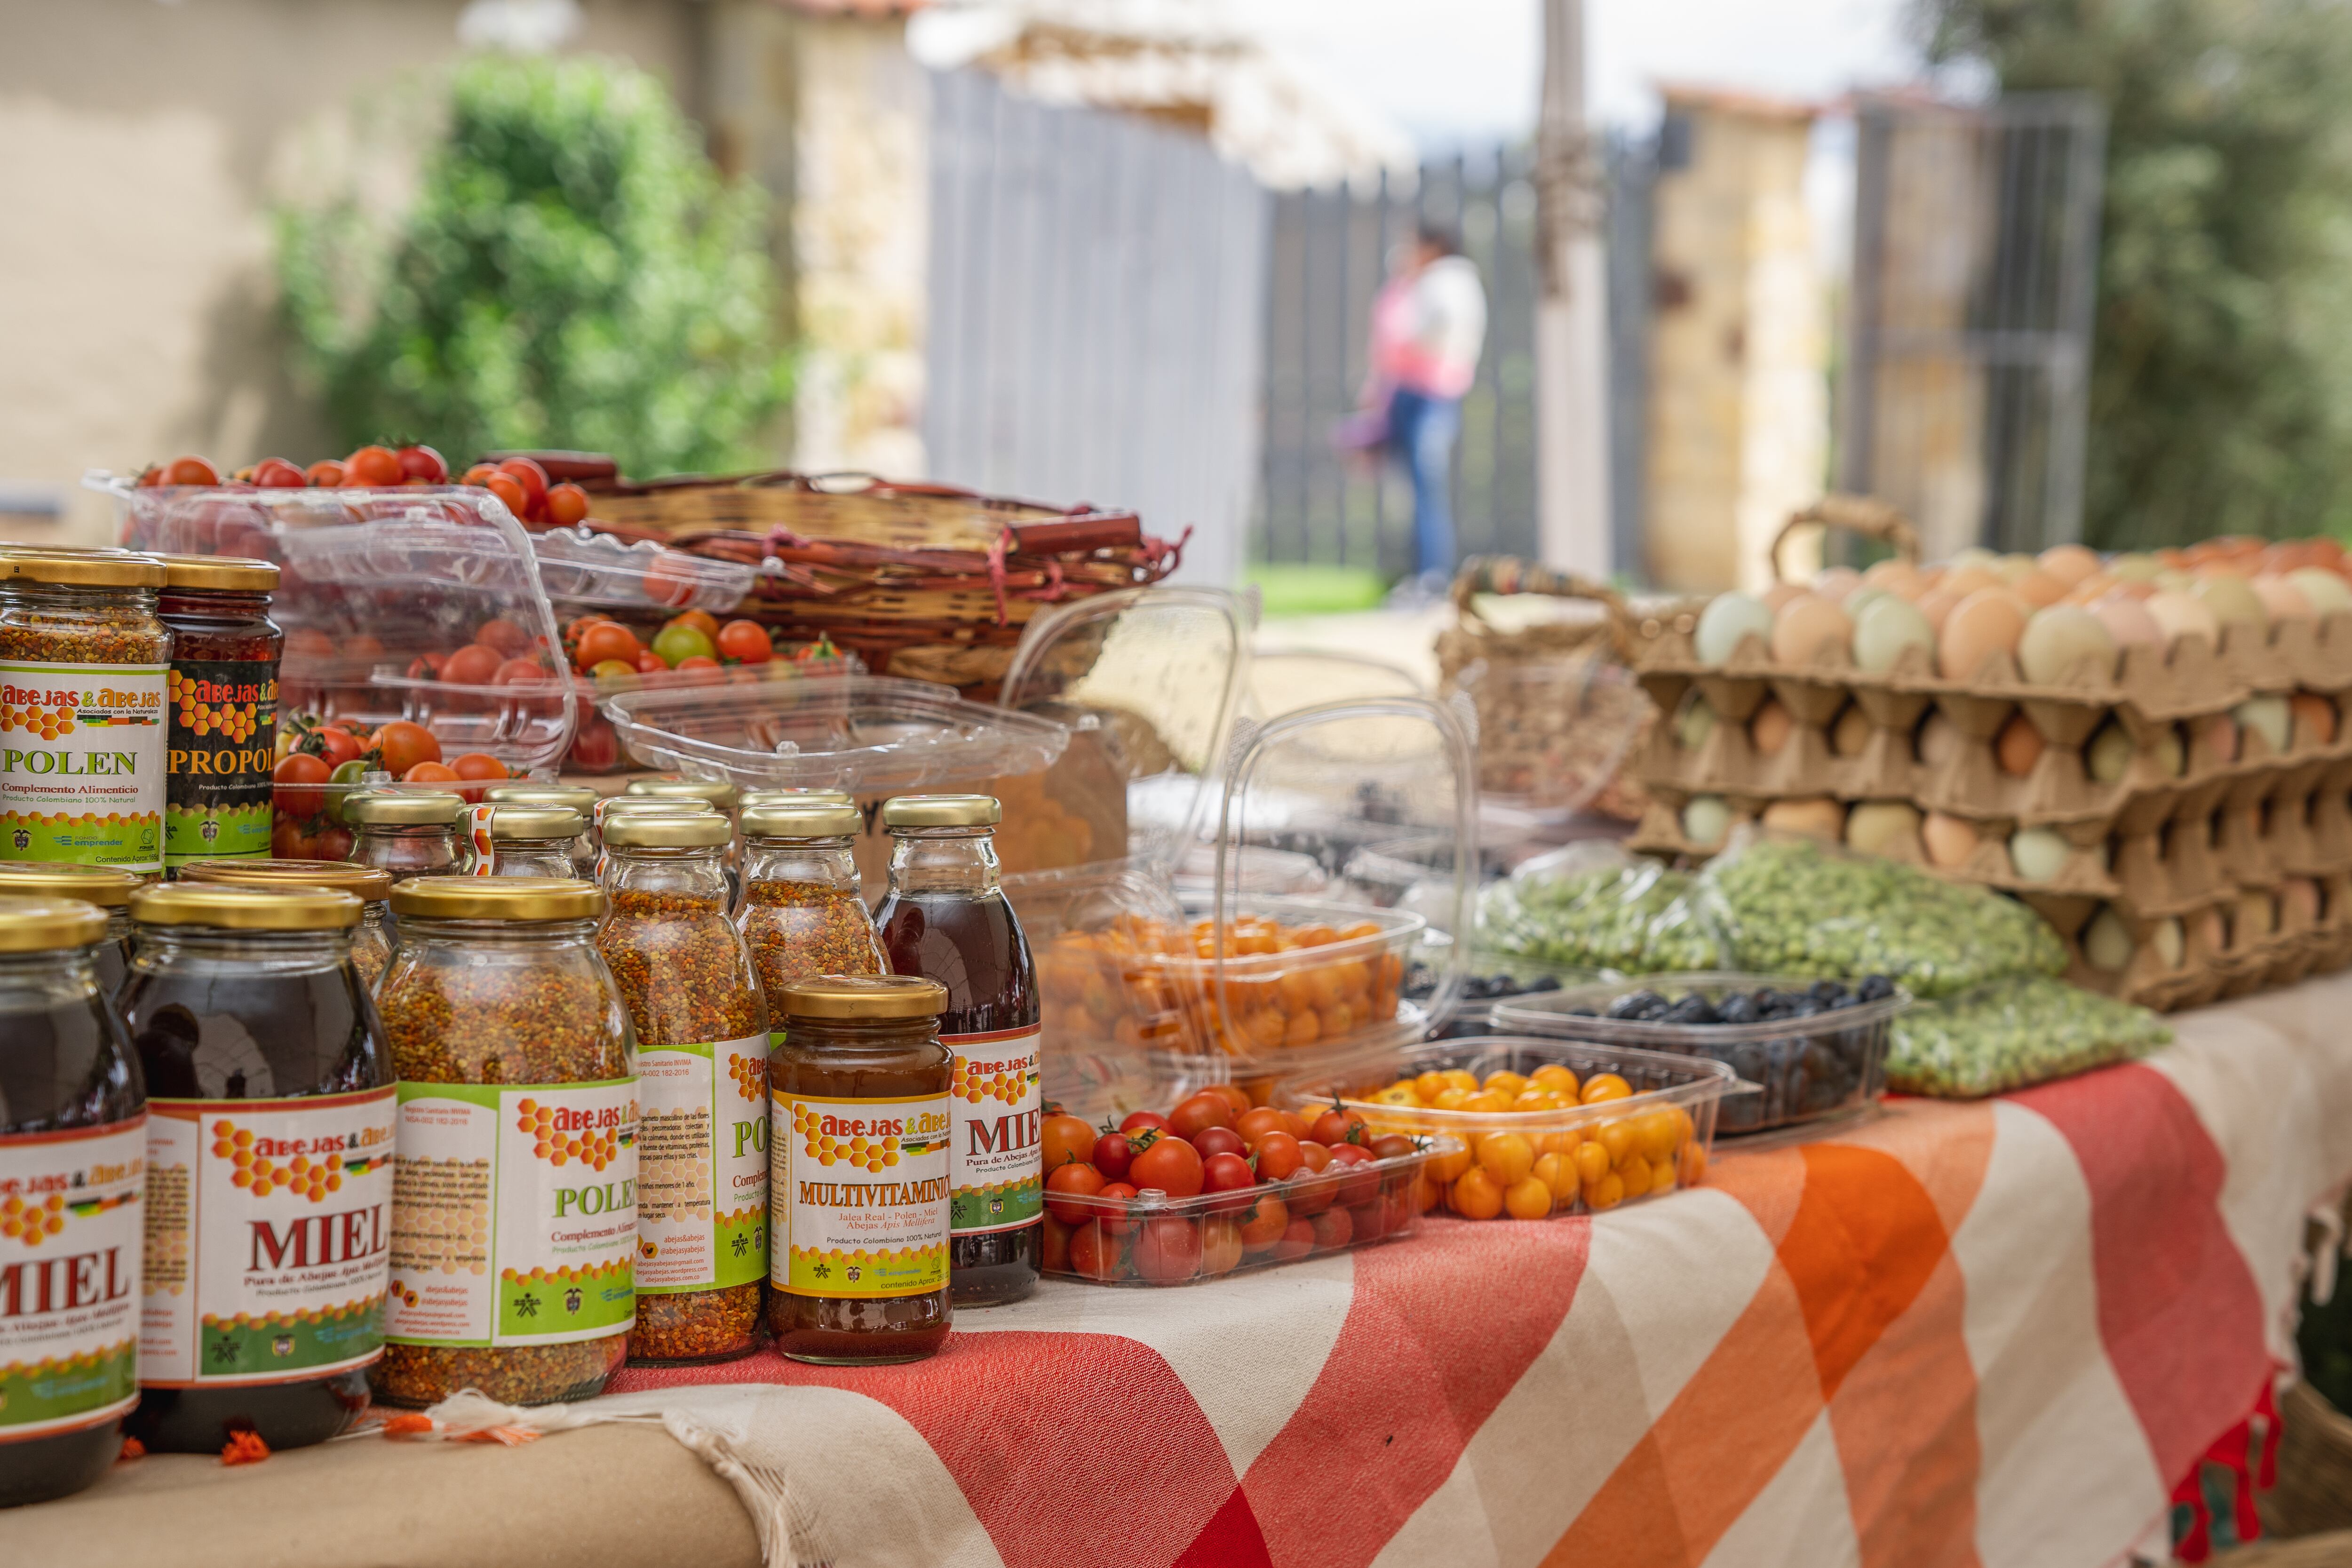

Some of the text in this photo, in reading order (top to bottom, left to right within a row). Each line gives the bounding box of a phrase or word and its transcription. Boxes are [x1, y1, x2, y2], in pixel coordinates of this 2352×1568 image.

[260, 683, 267, 701] &
[81, 691, 97, 707] &
[2, 749, 138, 775] POLEN
[2, 783, 138, 794] Complemento Alimenticio
[905, 1117, 918, 1135] &
[1004, 1153, 1027, 1162] Abejas
[1008, 1159, 1033, 1169] Colombiano
[734, 1190, 759, 1202] Producto
[924, 1208, 938, 1216] Miel
[847, 1218, 935, 1231] Abejas Apis Mellifera
[245, 1203, 388, 1271] MIEL
[551, 1227, 615, 1242] Complemento
[664, 1234, 705, 1244] abejas&abejas
[924, 1230, 942, 1240] Natural
[660, 1246, 705, 1256] @abejasyabejas
[637, 1258, 704, 1267] abejasyabejas@gmail.com
[636, 1266, 708, 1276] bejasyabejas.wordpress.com
[645, 1274, 700, 1283] abejasyabejas.com.co
[918, 1277, 936, 1286] Aprox:
